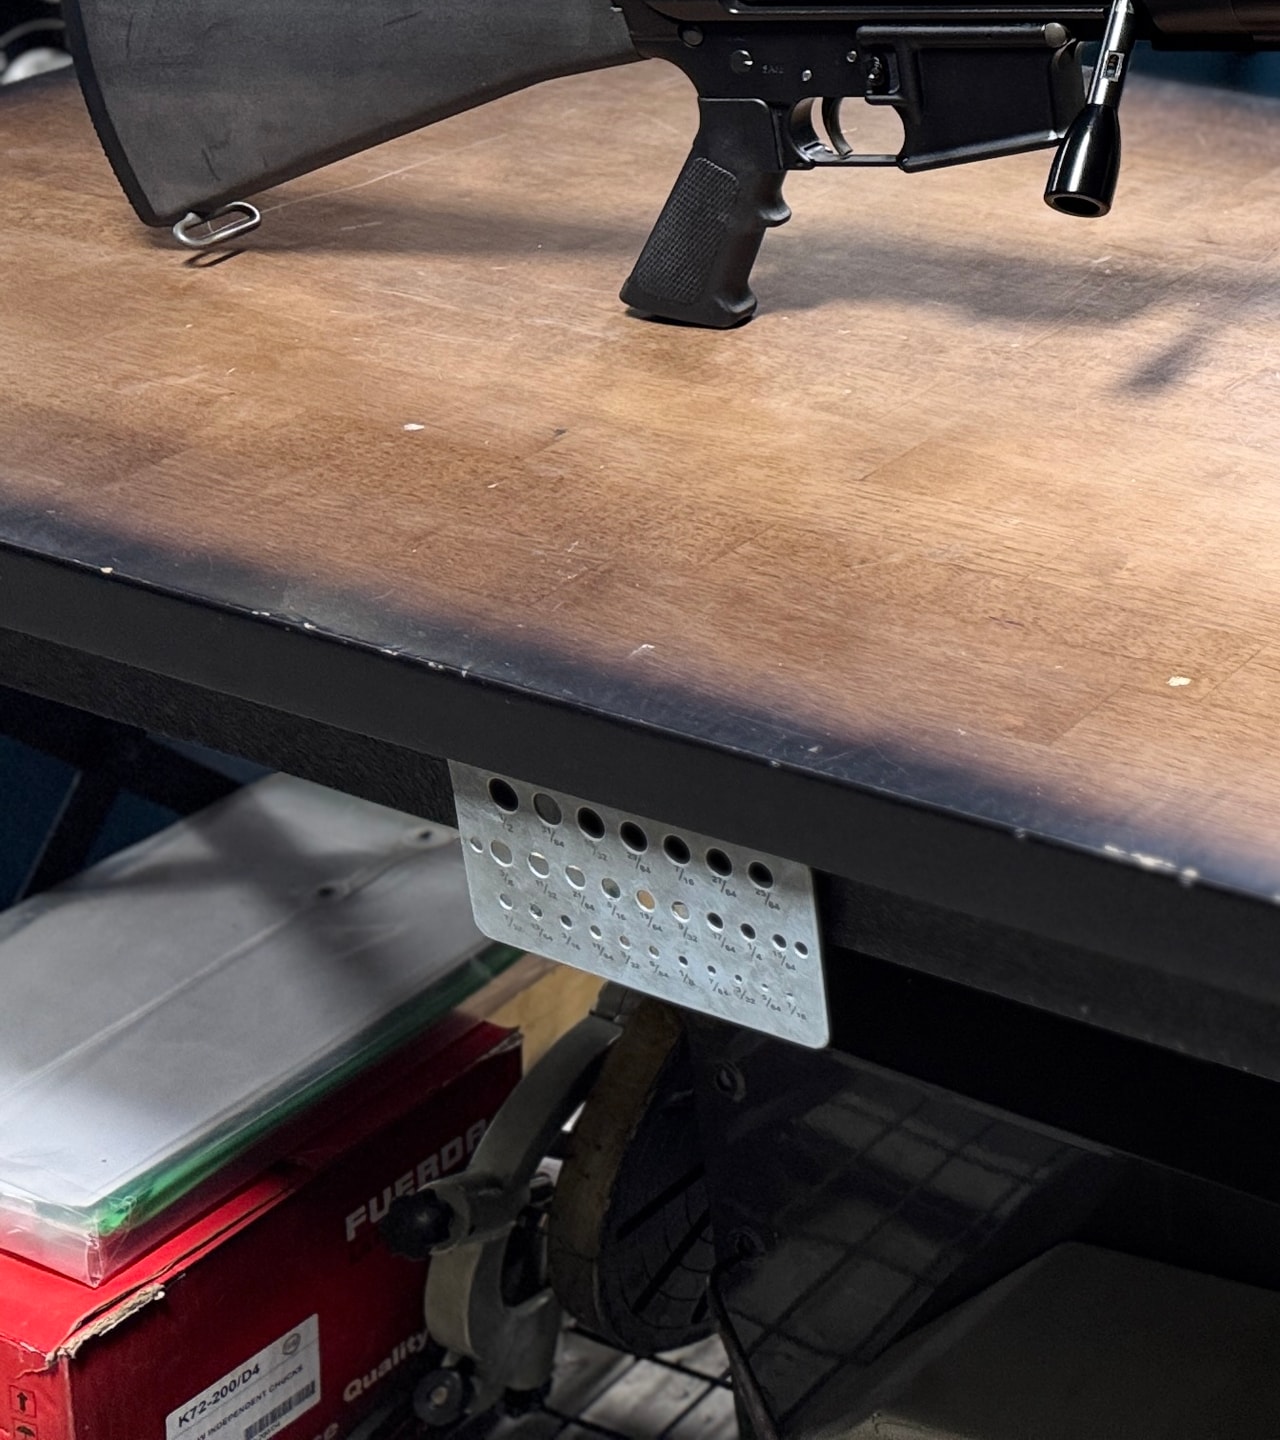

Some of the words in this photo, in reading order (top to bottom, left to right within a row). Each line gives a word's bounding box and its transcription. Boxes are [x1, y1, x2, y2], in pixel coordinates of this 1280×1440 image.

[178, 1362, 261, 1428] K72-200/D4
[343, 1328, 429, 1403] Quality
[207, 1389, 268, 1436] INDEPENDENT
